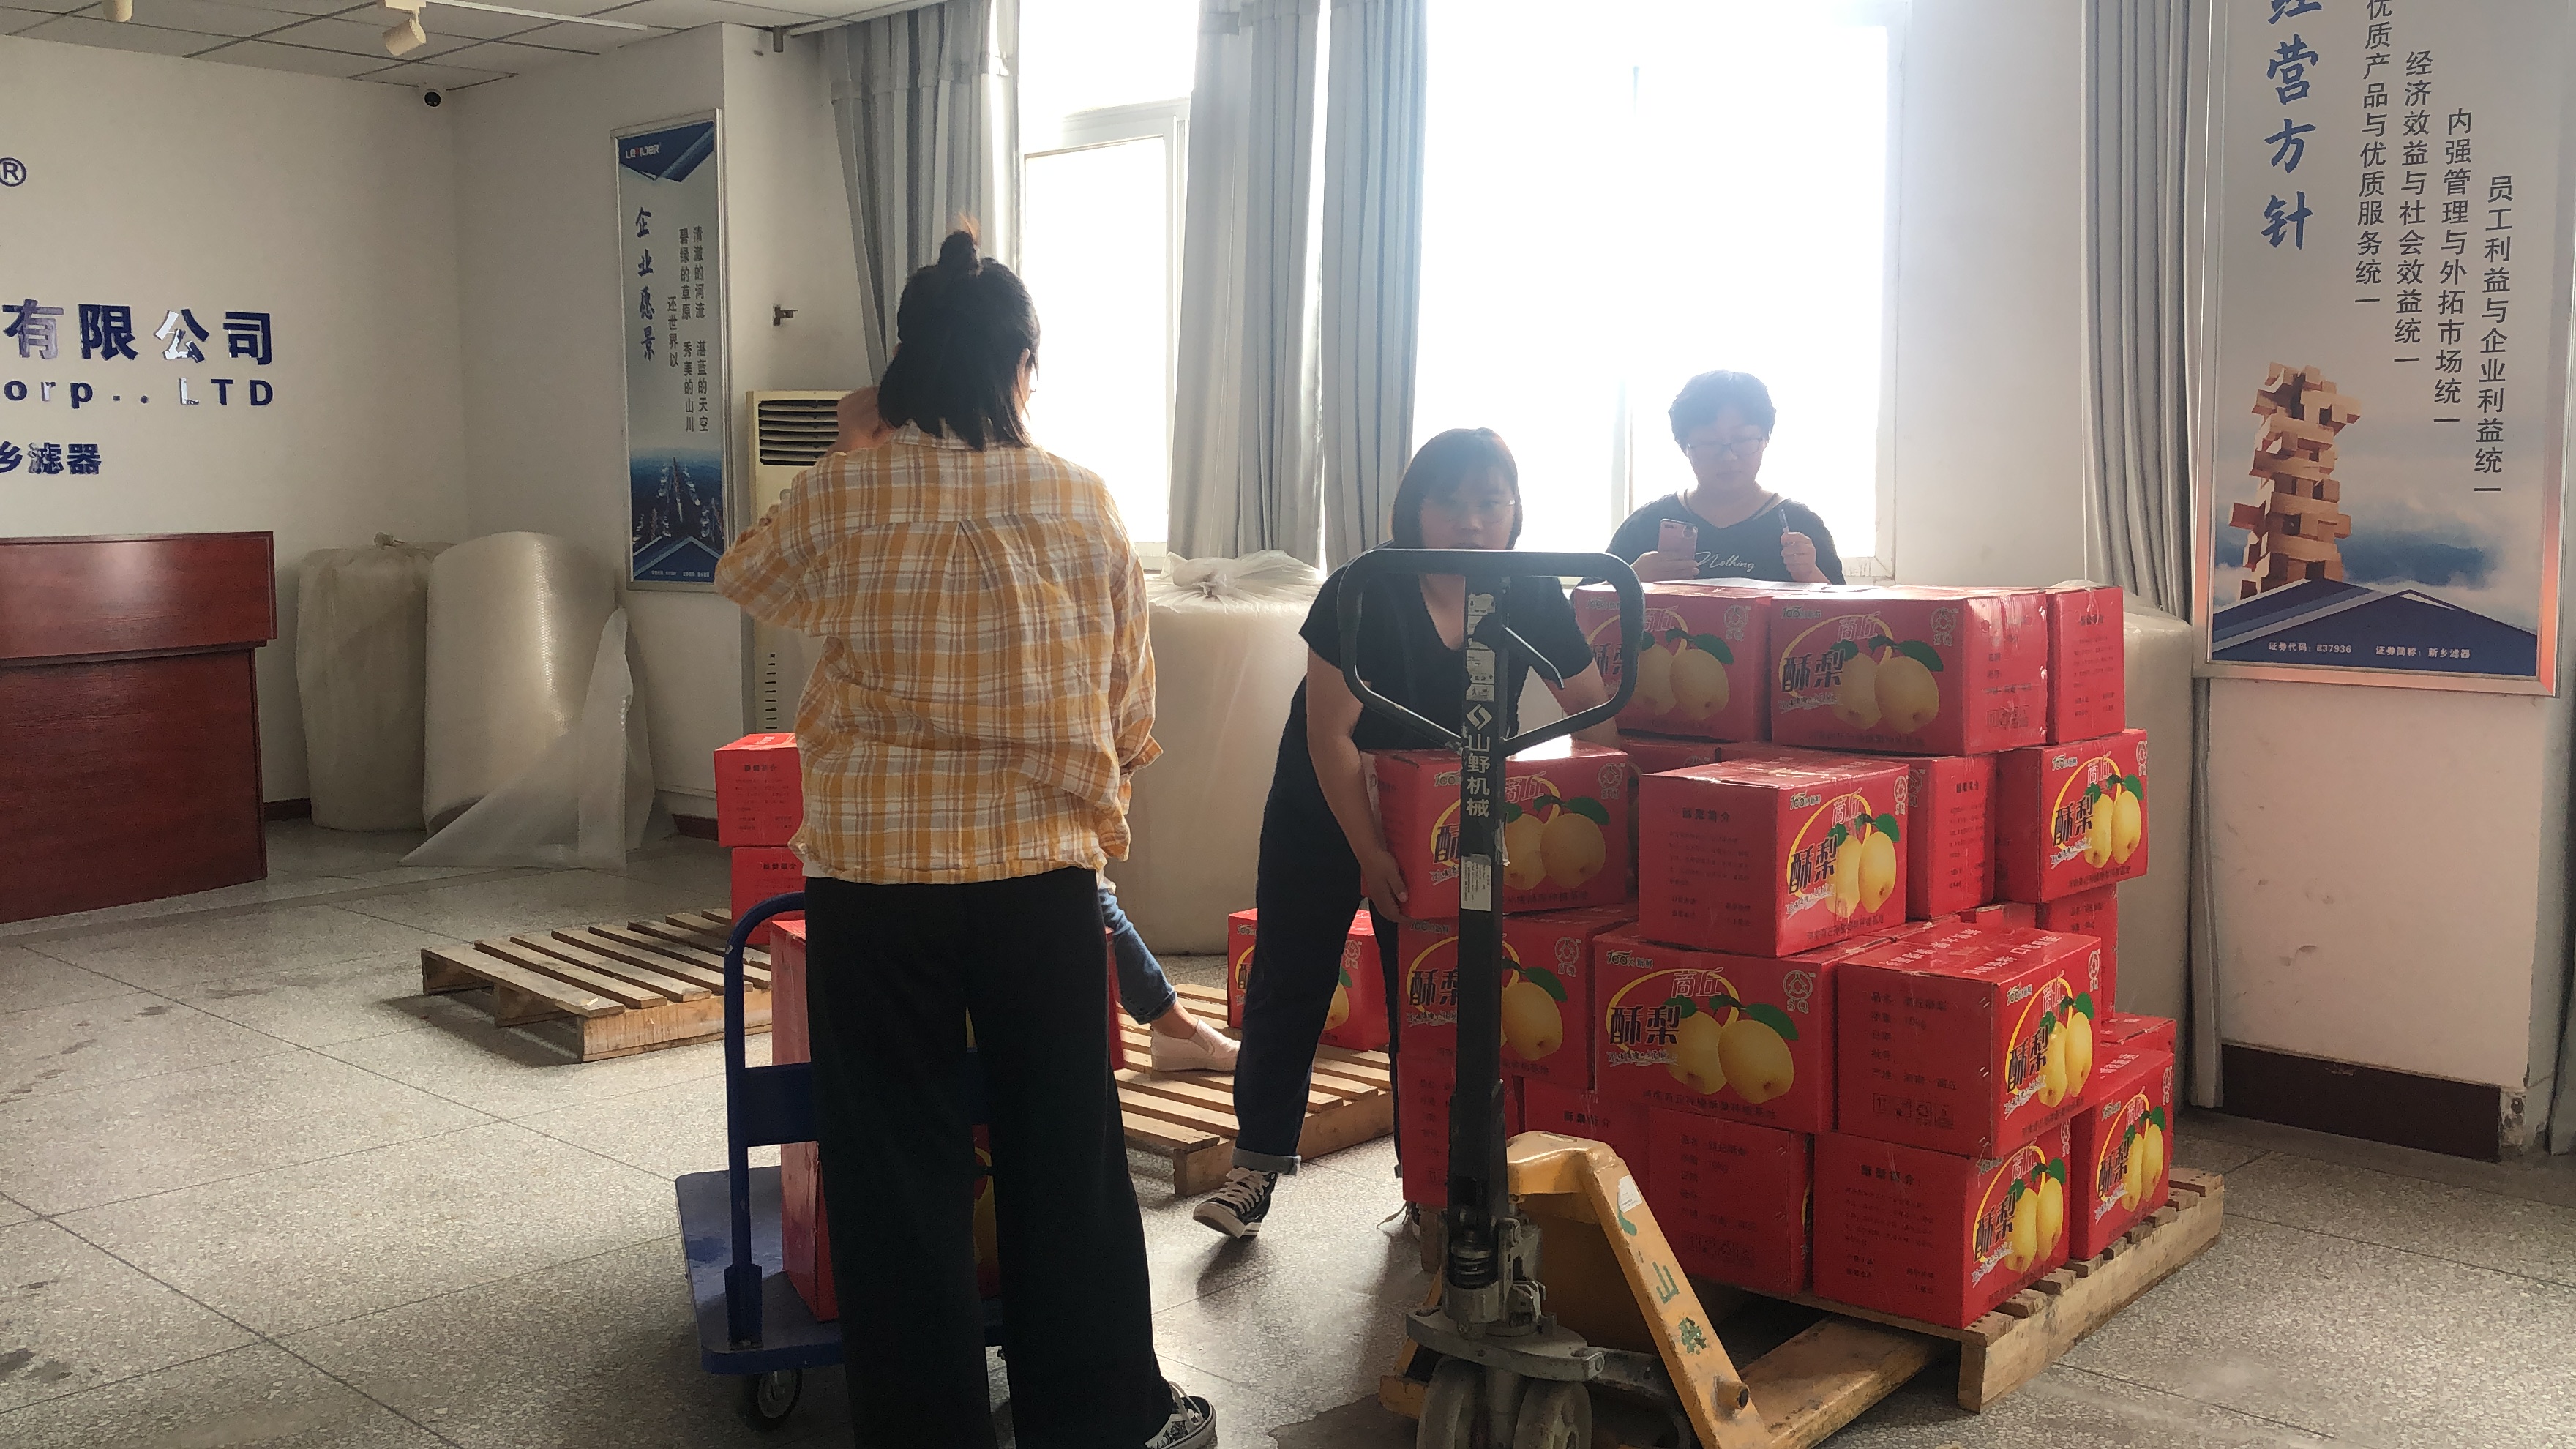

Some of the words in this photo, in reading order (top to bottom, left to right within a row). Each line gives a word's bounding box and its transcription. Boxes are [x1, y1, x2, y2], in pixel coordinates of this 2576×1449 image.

[2354, 0, 2392, 303] 优质产品与优质服务统一
[2394, 50, 2433, 362] 经济效益与社会效益统一
[635, 206, 656, 362] 企业愿景
[679, 227, 692, 320] 碧绿的草原
[2433, 108, 2472, 422] 内强管理与外拓市场统一
[2, 299, 272, 365] 有限公司
[667, 296, 679, 367] 还世界以
[2474, 175, 2514, 491] 员工利益与企业利益统一
[683, 341, 694, 432] 秀美的山川
[696, 340, 708, 432] 湛蓝的天空
[1837, 611, 1881, 643] 商丘
[1781, 647, 1846, 692] 酥梨
[1466, 734, 1491, 817] 山野机械
[1832, 787, 1863, 828] 商丘
[2053, 792, 2094, 847] 酥梨
[1788, 834, 1838, 895] 酥梨
[1670, 967, 1724, 999] 商丘
[1608, 1004, 1682, 1046] 酥梨
[2007, 1022, 2048, 1093] 酥梨
[2098, 1134, 2131, 1200] 酥梨
[1973, 1188, 2017, 1264] 酥梨
